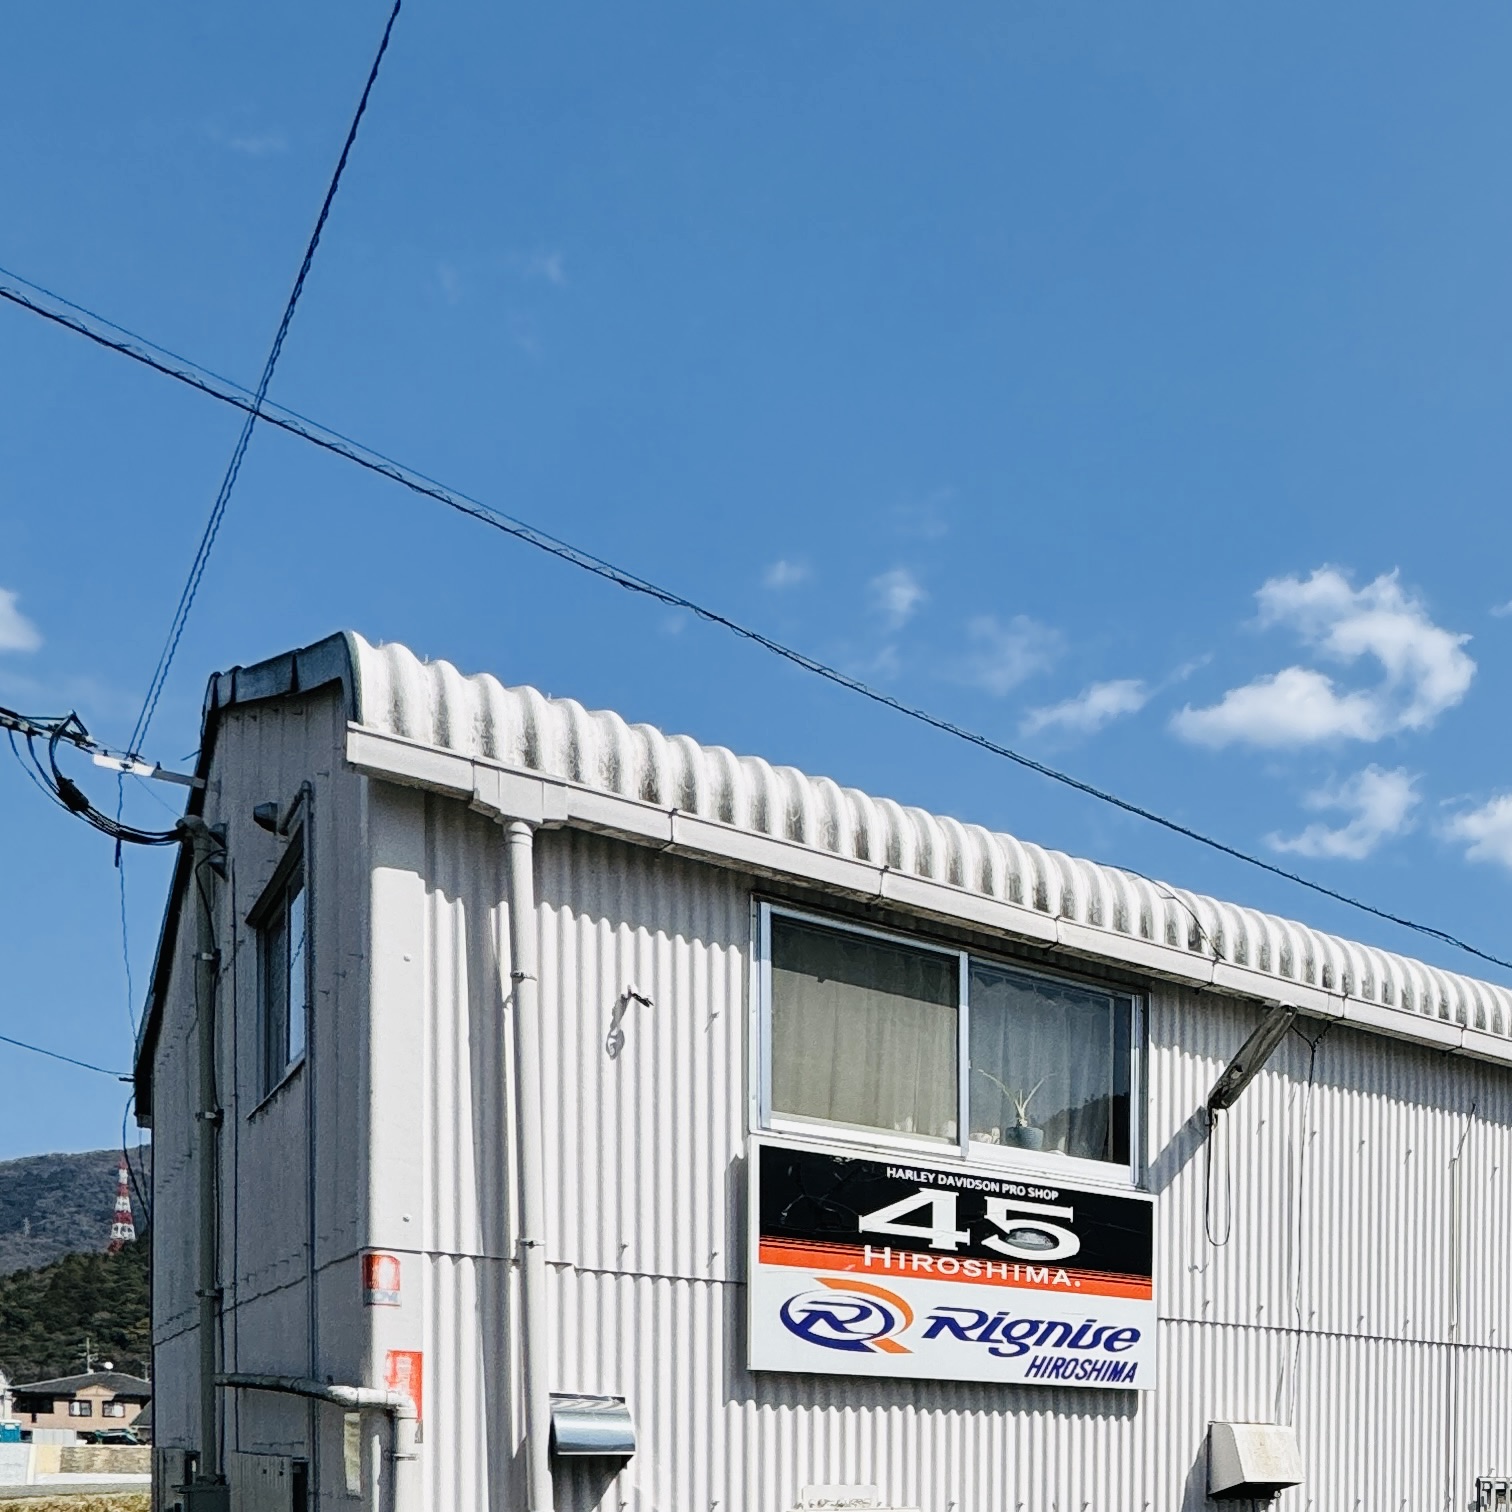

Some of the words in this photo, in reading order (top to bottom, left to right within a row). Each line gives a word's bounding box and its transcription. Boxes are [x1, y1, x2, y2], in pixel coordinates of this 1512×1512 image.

[886, 1166, 936, 1184] HARLEY
[938, 1174, 1000, 1193] DAVIDSON
[1002, 1183, 1026, 1197] PRO
[1027, 1187, 1059, 1201] SHOP
[858, 1187, 1081, 1261] 45
[1024, 1355, 1140, 1384] HIROSHIMA
